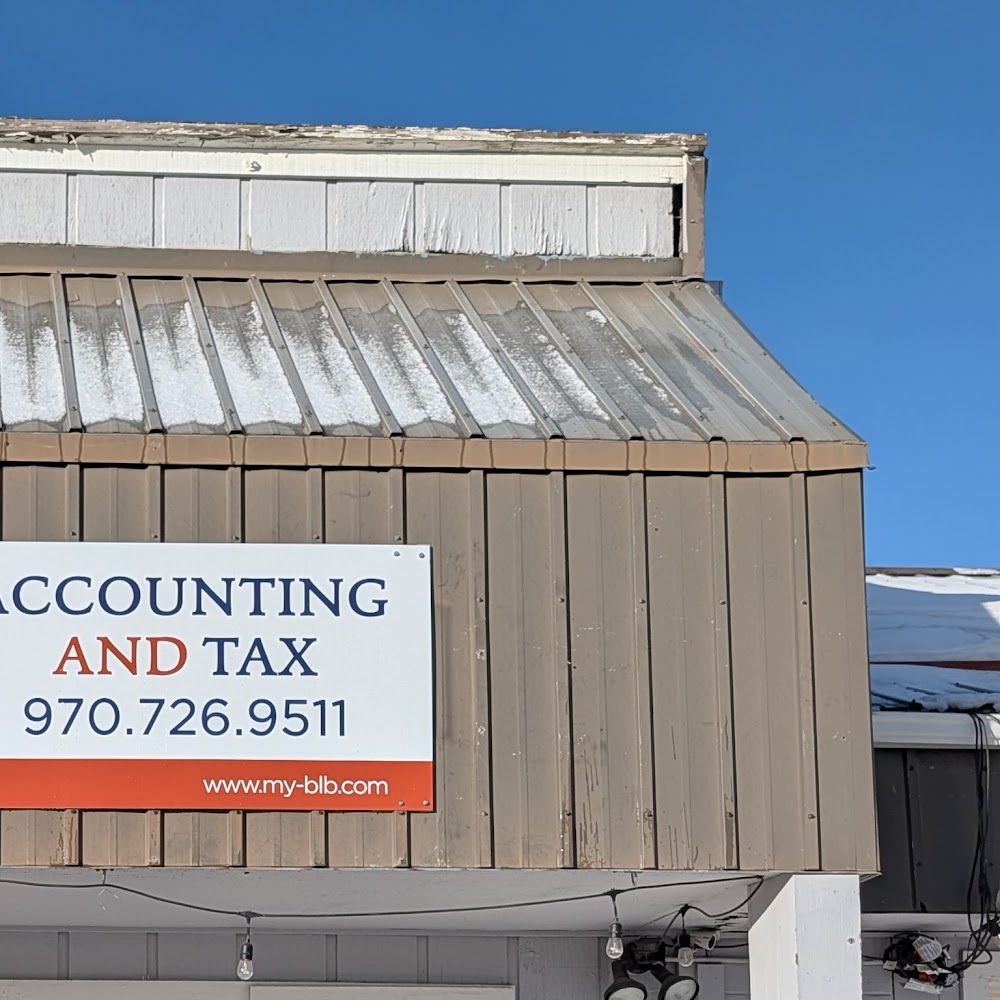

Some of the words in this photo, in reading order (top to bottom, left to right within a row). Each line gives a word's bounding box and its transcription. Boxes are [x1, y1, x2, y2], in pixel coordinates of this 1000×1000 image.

[52, 636, 188, 676] AND
[202, 636, 319, 677] TAX
[23, 697, 345, 737] 970.726.9511
[203, 774, 389, 798] www.my-blb.com
